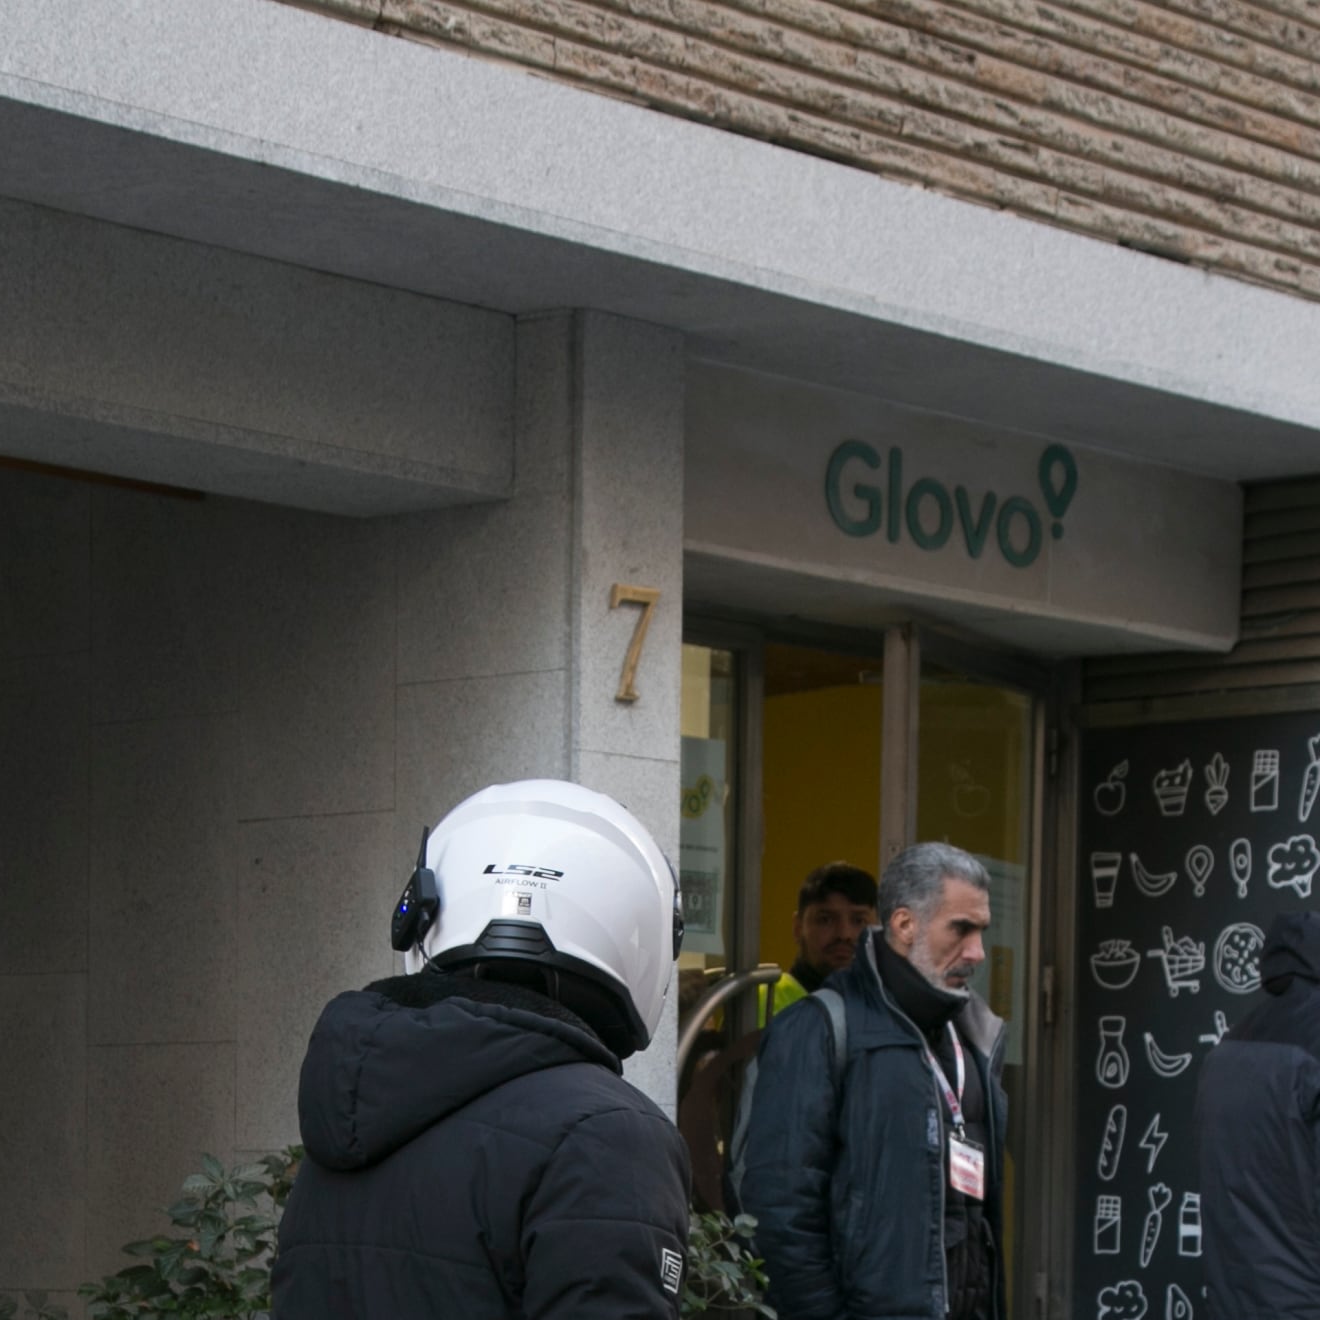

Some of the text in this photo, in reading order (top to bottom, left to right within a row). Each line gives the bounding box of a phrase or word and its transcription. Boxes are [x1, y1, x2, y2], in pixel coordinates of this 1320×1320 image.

[824, 438, 1043, 569] Glovo
[609, 582, 661, 704] 7
[483, 864, 564, 881] LS2
